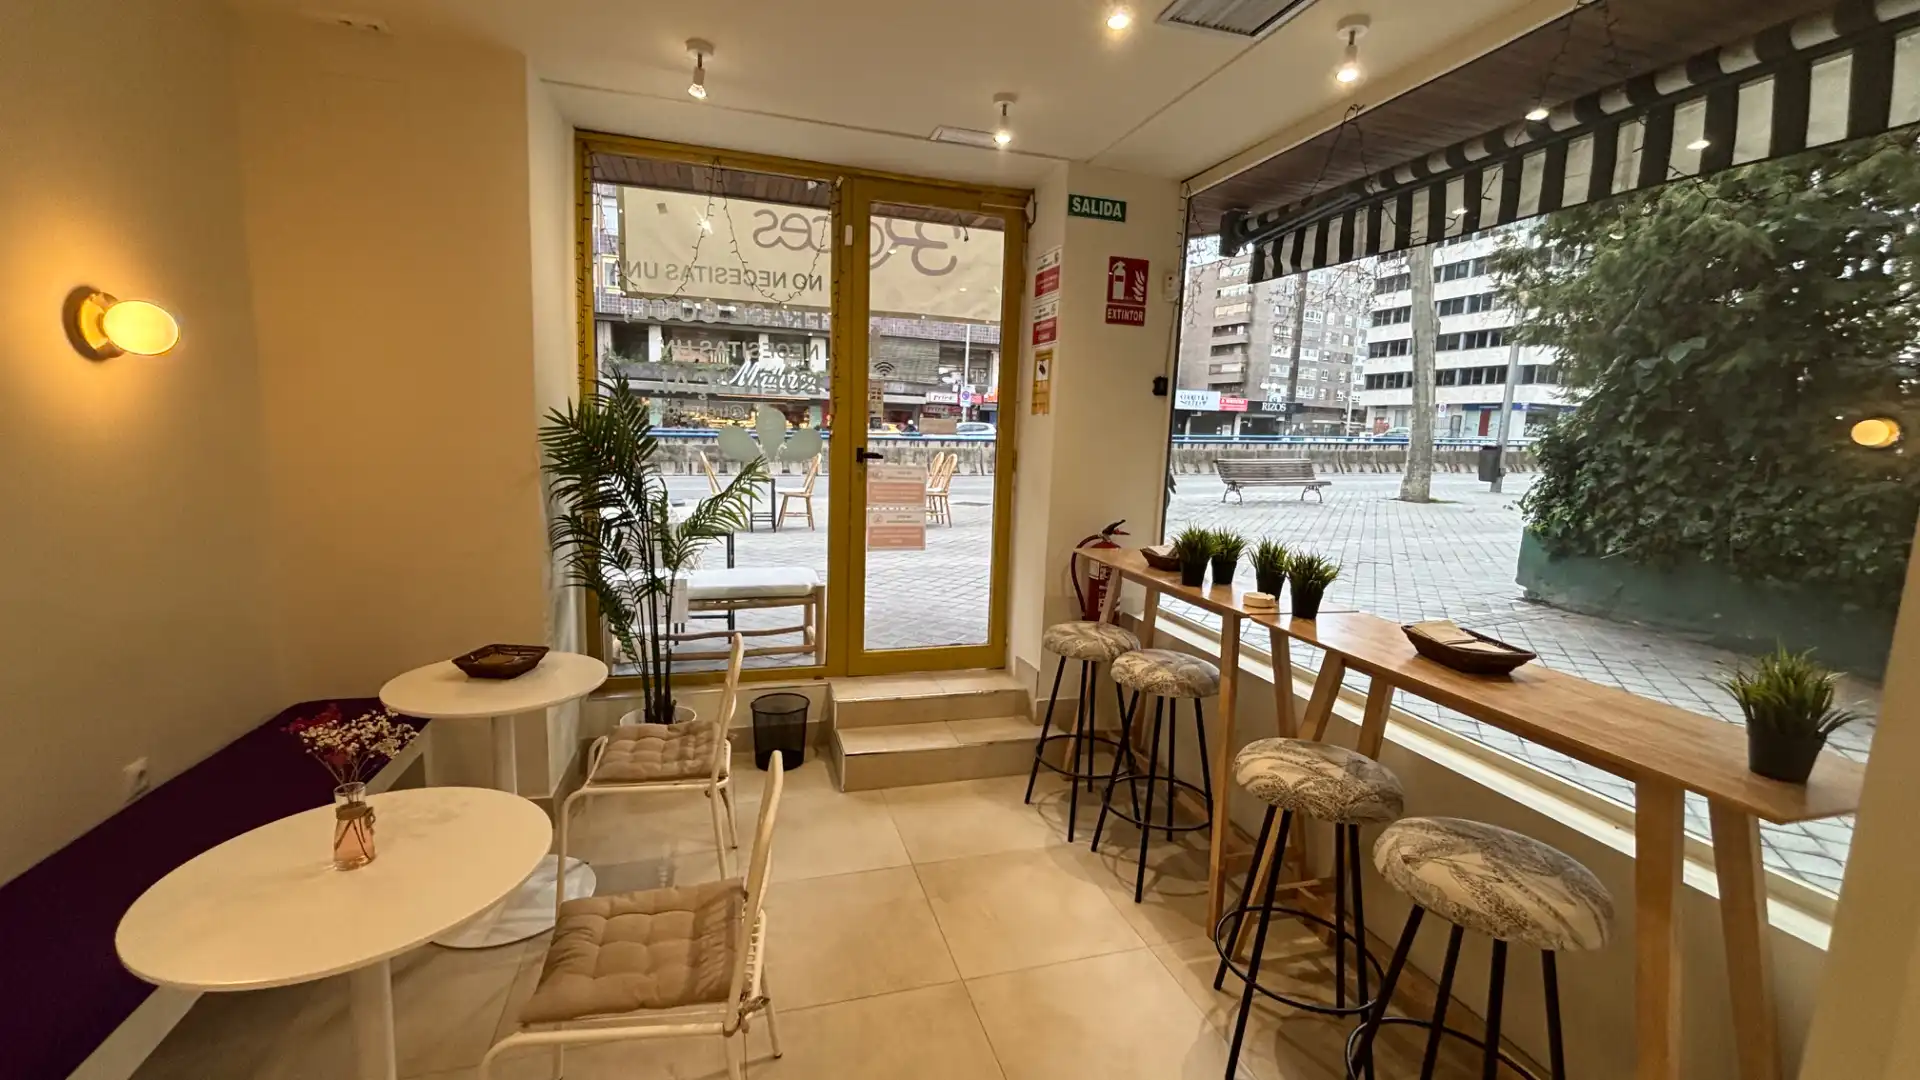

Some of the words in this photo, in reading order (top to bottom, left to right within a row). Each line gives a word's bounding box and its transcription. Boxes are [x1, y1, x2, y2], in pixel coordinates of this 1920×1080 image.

[1072, 197, 1122, 217] SALIDA
[1108, 309, 1144, 321] EXTINTOR
[1261, 402, 1287, 411] RIZOS
